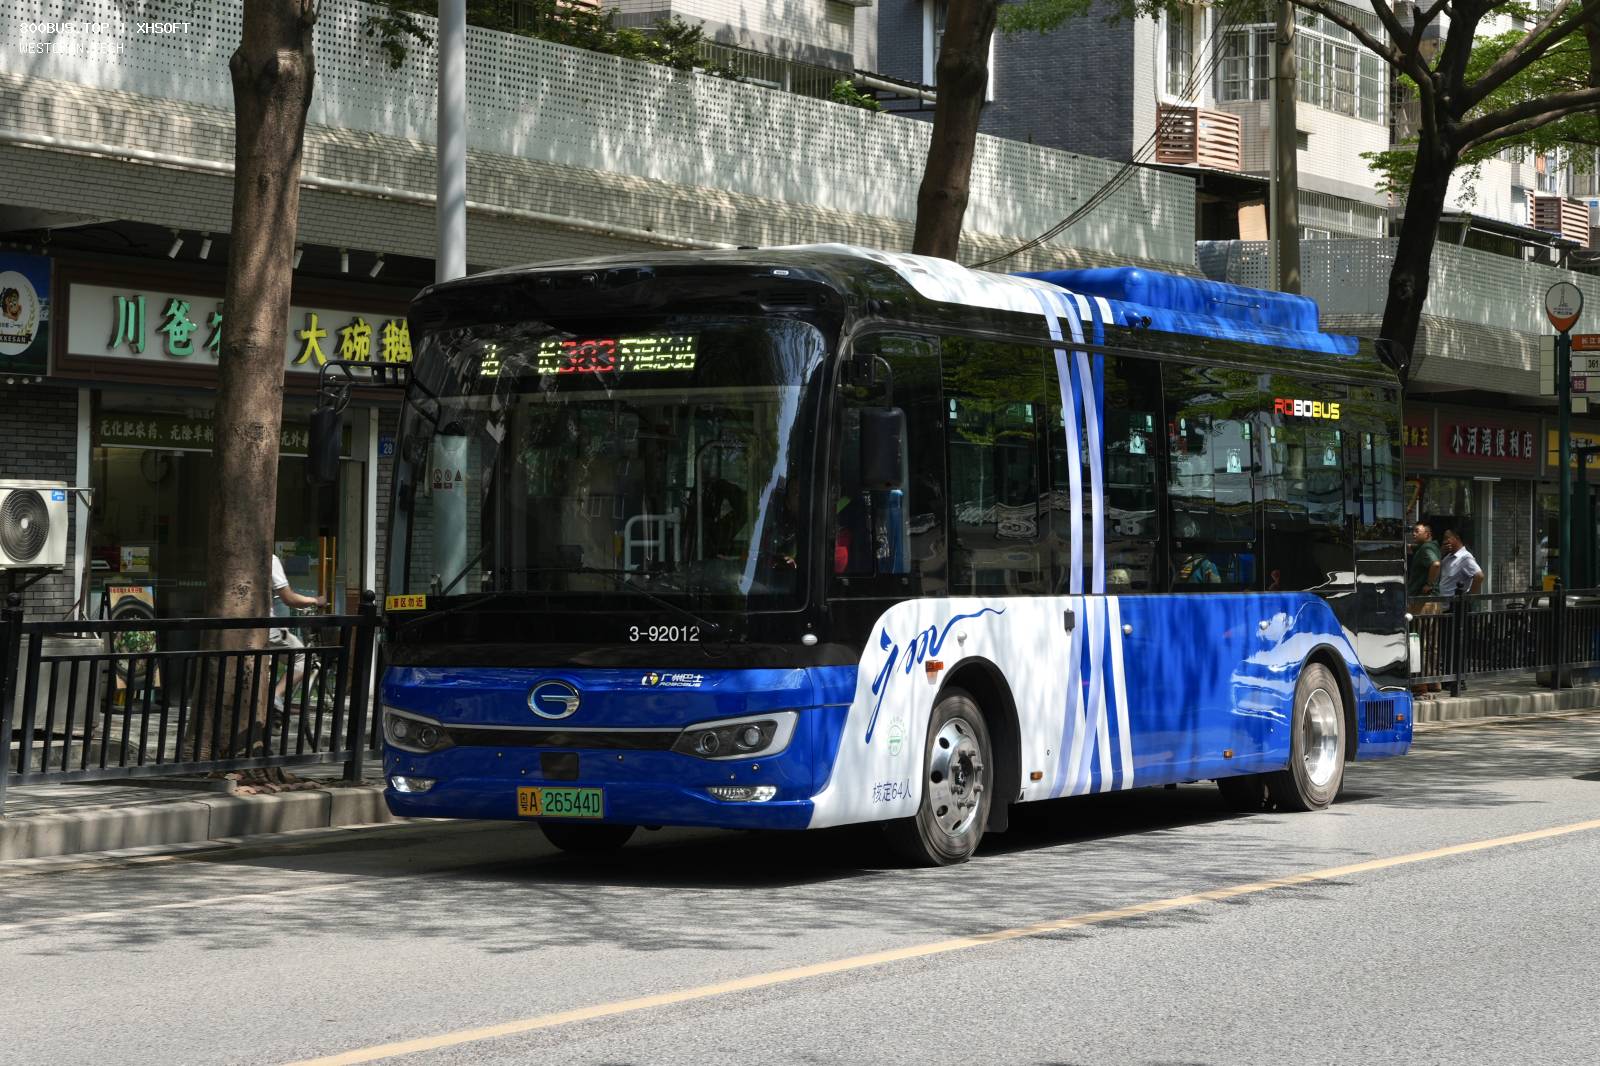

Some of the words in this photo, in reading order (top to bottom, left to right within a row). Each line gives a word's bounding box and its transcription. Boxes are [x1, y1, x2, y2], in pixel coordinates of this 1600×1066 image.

[1274, 398, 1340, 420] ROBOBUS
[1452, 425, 1532, 458] 小河湾便利店
[629, 625, 700, 642] 3-92012
[661, 673, 704, 683] 广州巴士
[872, 779, 912, 804] 核定64人
